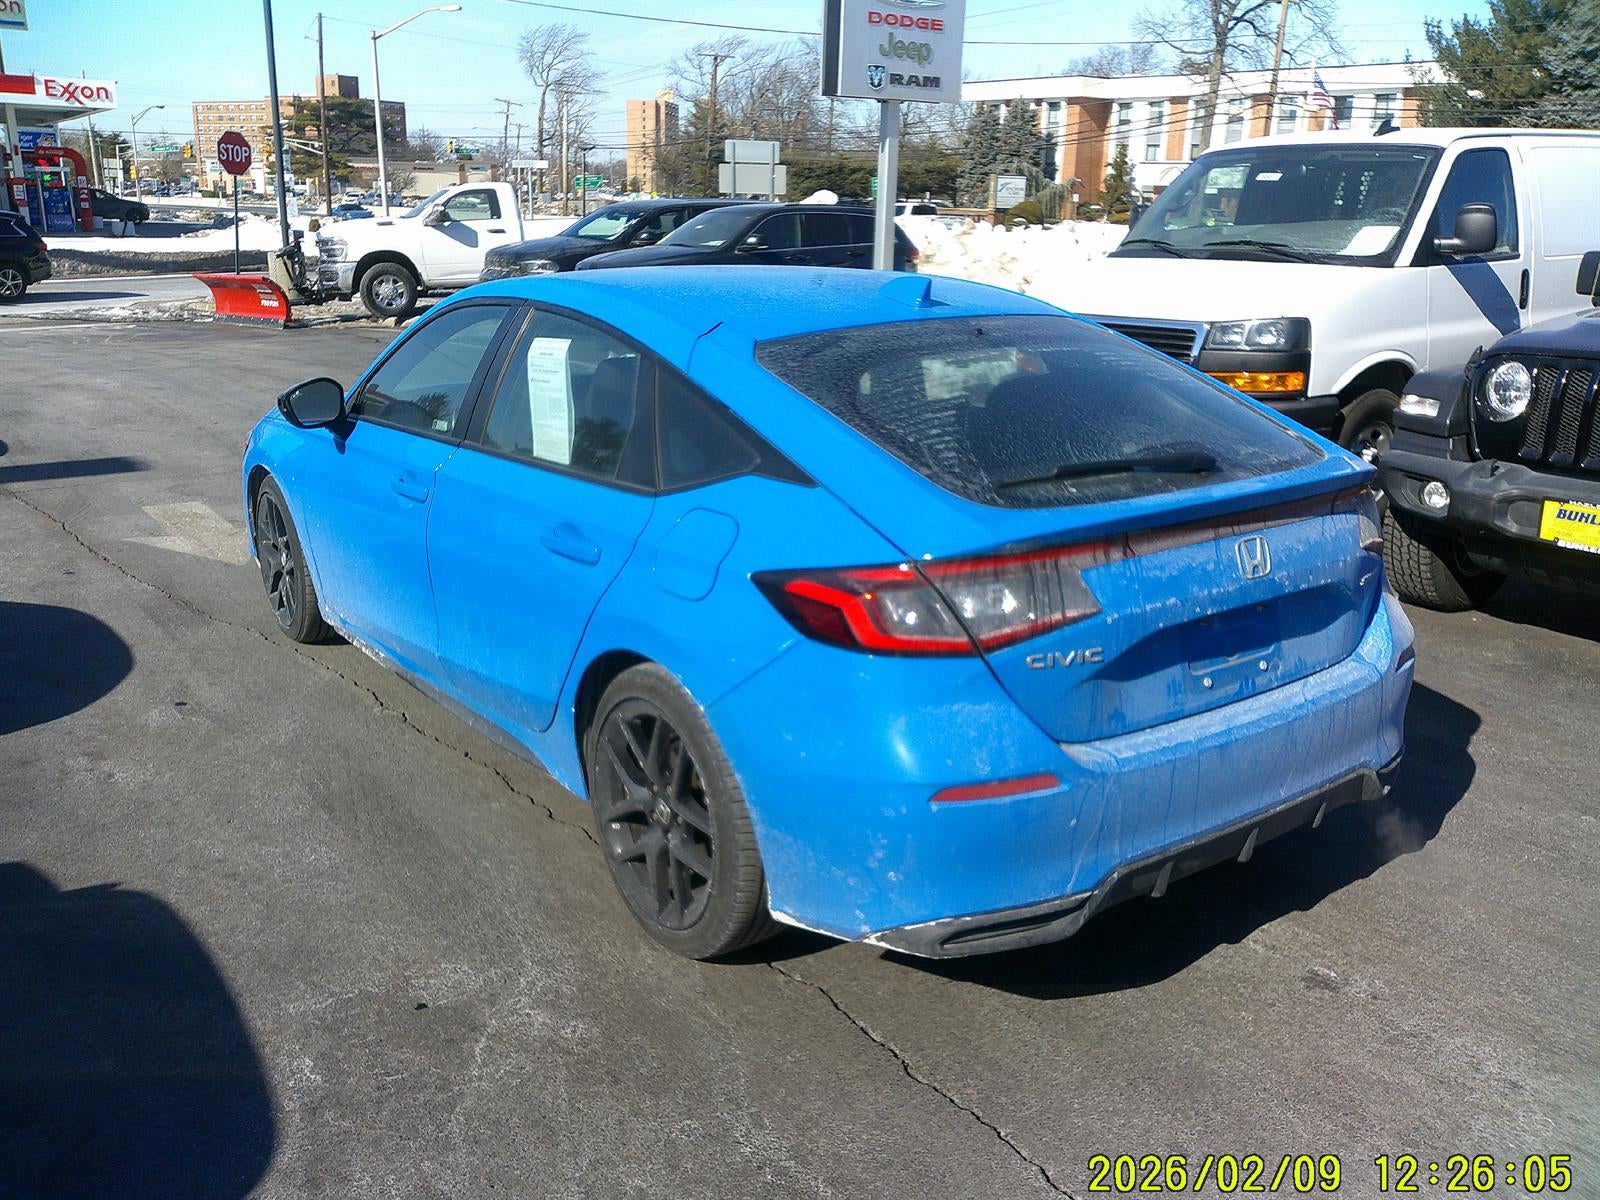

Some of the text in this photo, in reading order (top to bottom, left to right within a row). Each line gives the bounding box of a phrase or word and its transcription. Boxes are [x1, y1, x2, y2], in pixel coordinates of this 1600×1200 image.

[868, 11, 944, 31] DODGE
[879, 32, 932, 65] Jeep
[889, 73, 941, 88] RAM
[44, 79, 110, 105] Exxon
[219, 143, 250, 163] STOP
[1026, 647, 1104, 669] CIVIC
